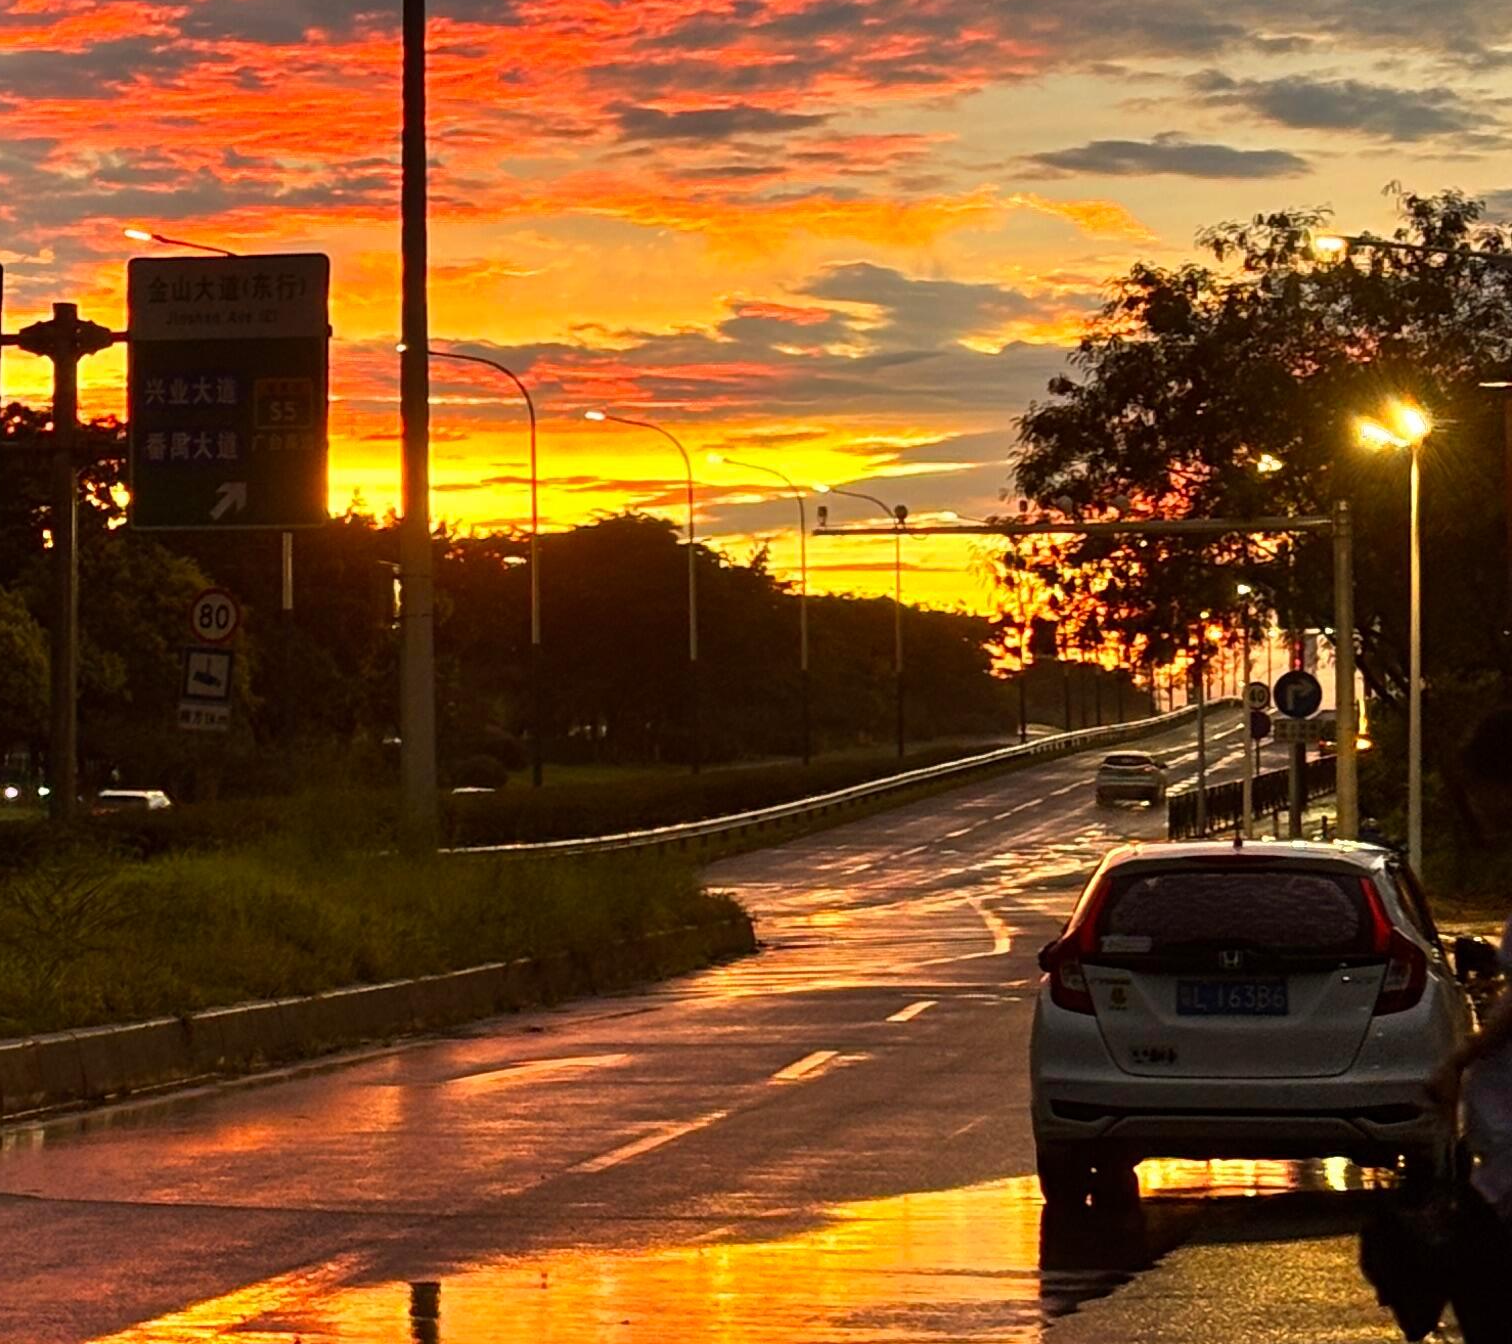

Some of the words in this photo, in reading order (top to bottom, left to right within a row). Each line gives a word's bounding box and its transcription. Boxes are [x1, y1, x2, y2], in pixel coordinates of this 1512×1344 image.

[149, 273, 305, 303] 金山大道(东行)
[144, 376, 237, 405] 兴业大道
[270, 401, 296, 421] S5
[146, 432, 237, 460] 番禺大道
[200, 604, 229, 629] 80
